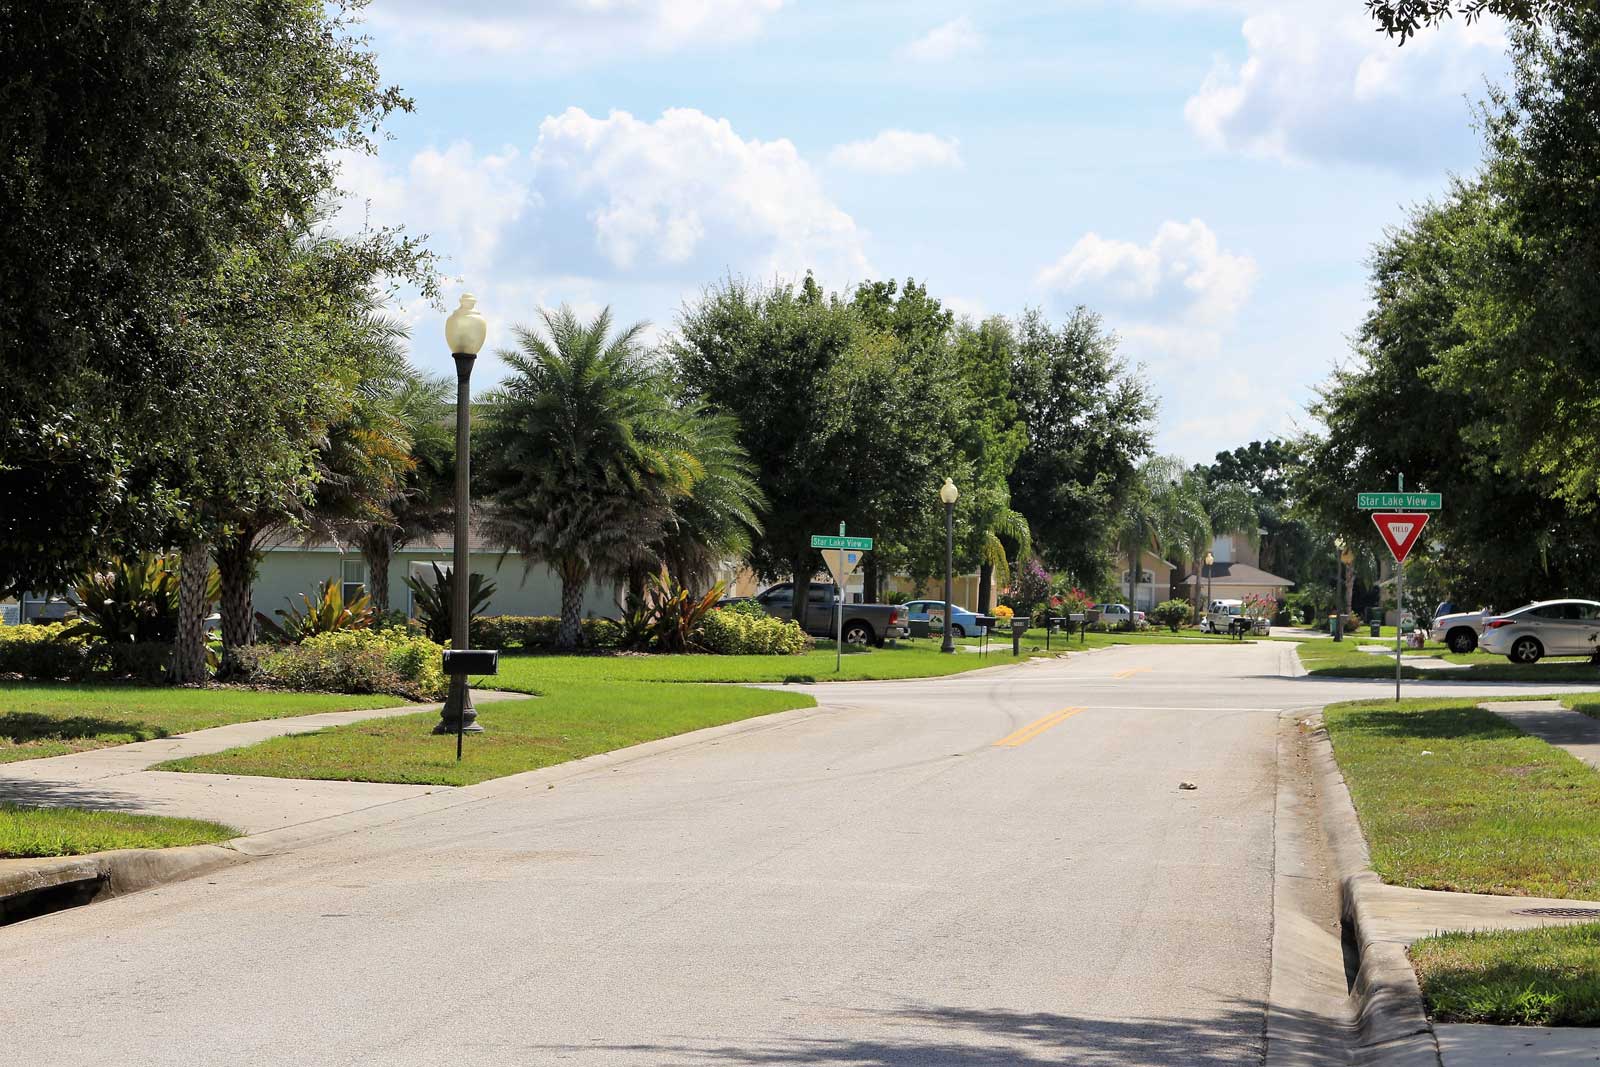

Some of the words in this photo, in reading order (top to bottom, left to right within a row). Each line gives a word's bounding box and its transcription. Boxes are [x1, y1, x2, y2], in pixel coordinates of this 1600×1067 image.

[1360, 496, 1379, 506] Star
[1382, 496, 1403, 506] Lake
[1407, 496, 1427, 506] View
[813, 537, 826, 546] Star
[829, 538, 845, 547] Lake
[847, 539, 862, 547] View
